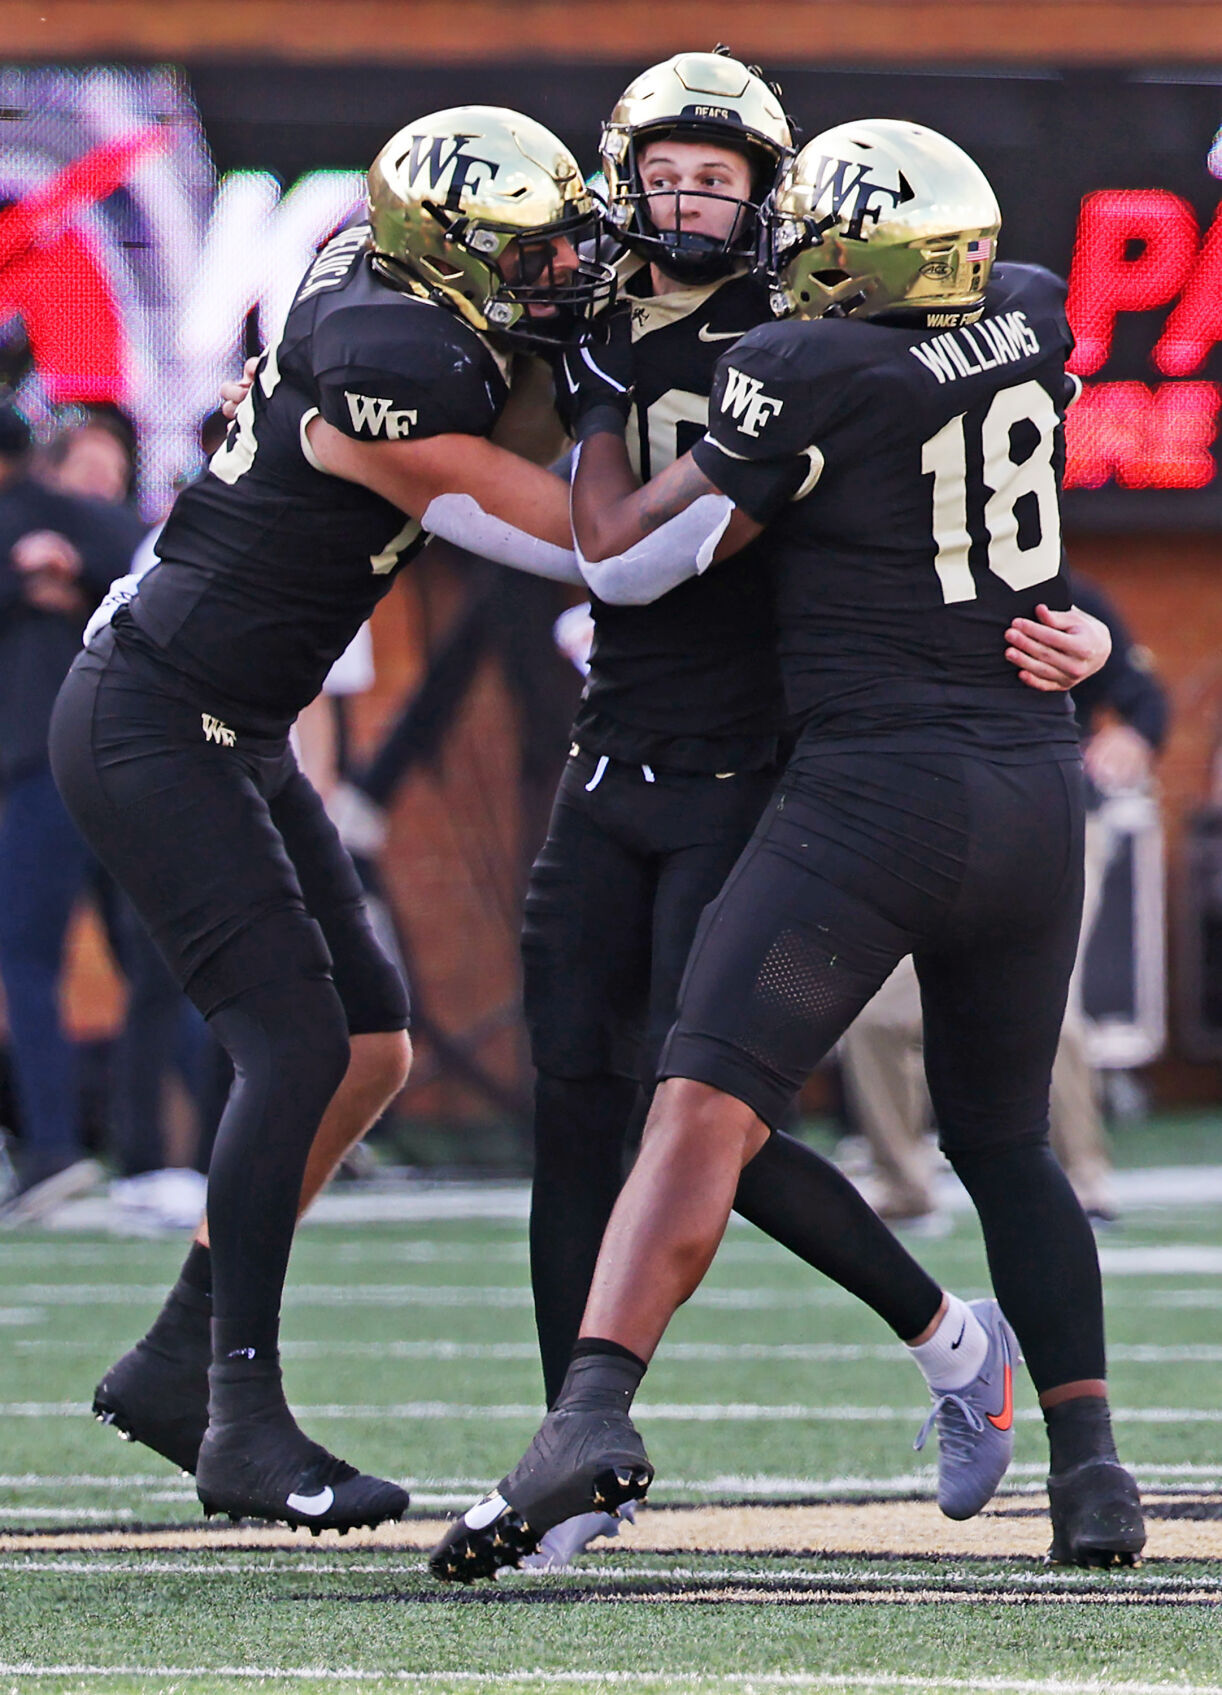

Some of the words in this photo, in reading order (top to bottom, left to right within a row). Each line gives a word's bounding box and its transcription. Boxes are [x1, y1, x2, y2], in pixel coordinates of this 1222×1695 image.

[408, 134, 500, 215] WF
[811, 155, 901, 242] WF
[909, 310, 1041, 384] WILLIAMS
[926, 313, 960, 327] WAKE
[343, 390, 418, 440] WF
[721, 366, 784, 438] WF
[921, 379, 1062, 604] 18
